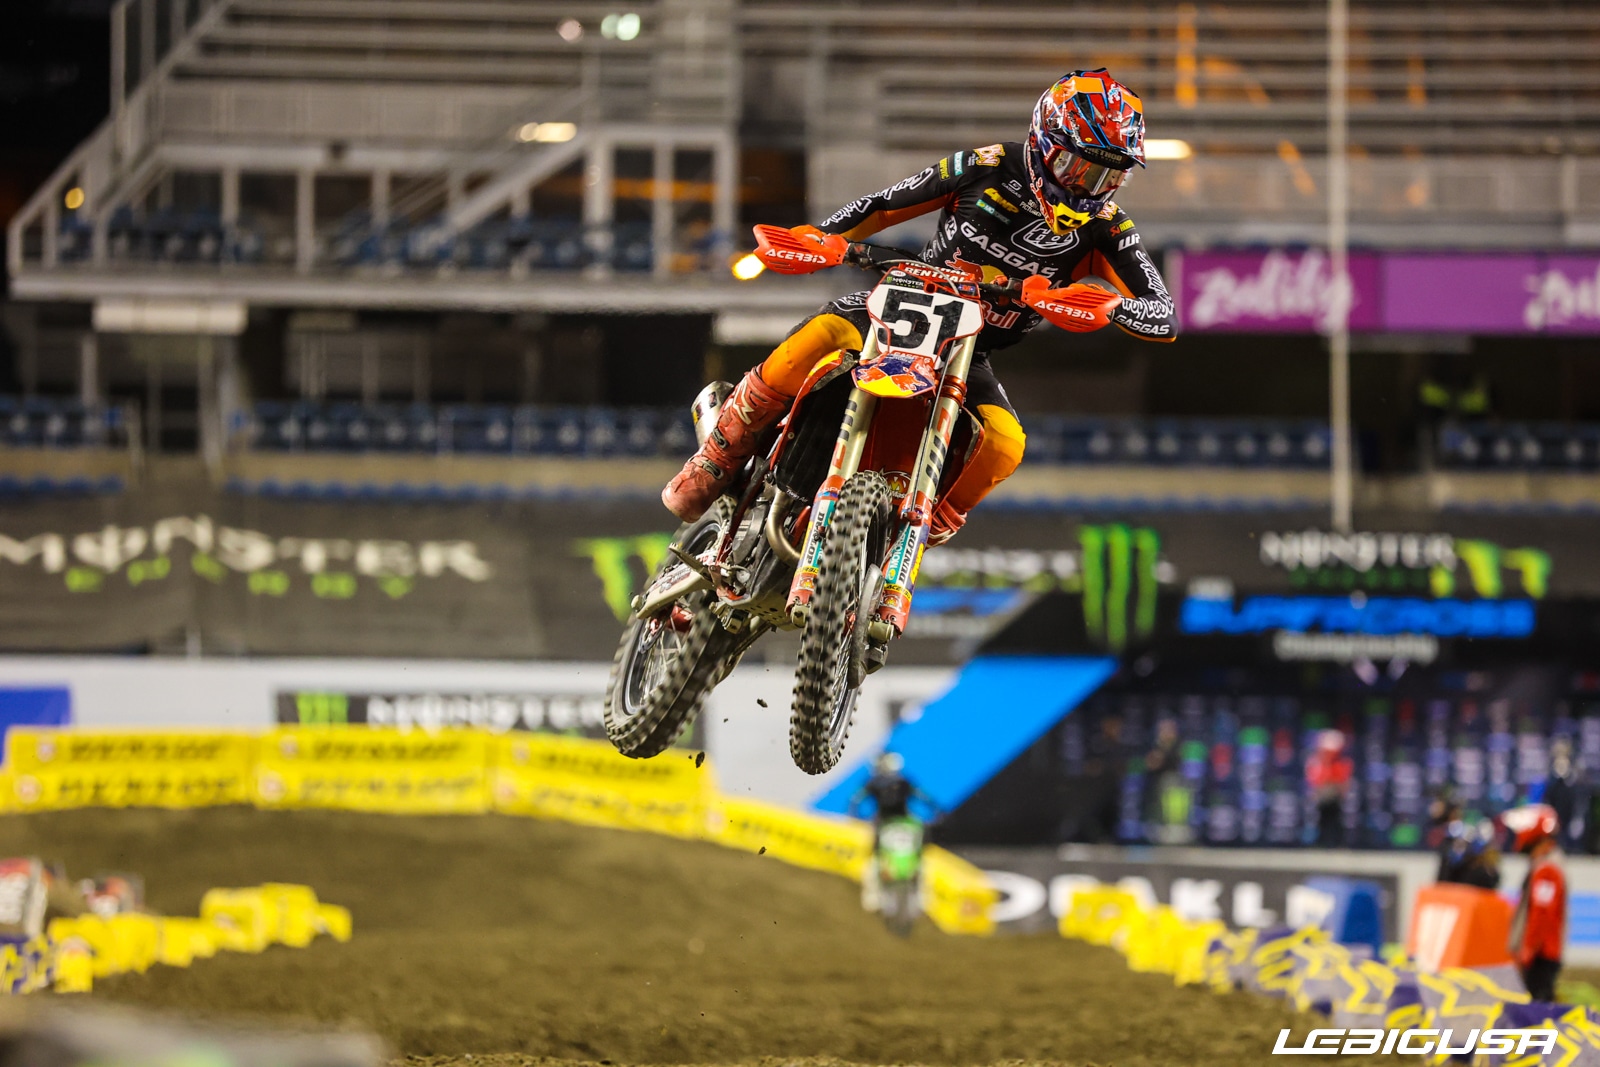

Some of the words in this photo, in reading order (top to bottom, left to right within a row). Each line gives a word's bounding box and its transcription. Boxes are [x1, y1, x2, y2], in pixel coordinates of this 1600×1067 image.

[765, 248, 827, 265] ACERBIS
[960, 221, 1059, 279] GASGAS
[892, 276, 924, 288] MONSTER
[904, 266, 966, 283] RENTHAL
[1034, 300, 1096, 321] ACERBIS
[878, 288, 964, 362] 51
[1114, 314, 1170, 335] GASGAS
[898, 529, 916, 586] DUNLOP
